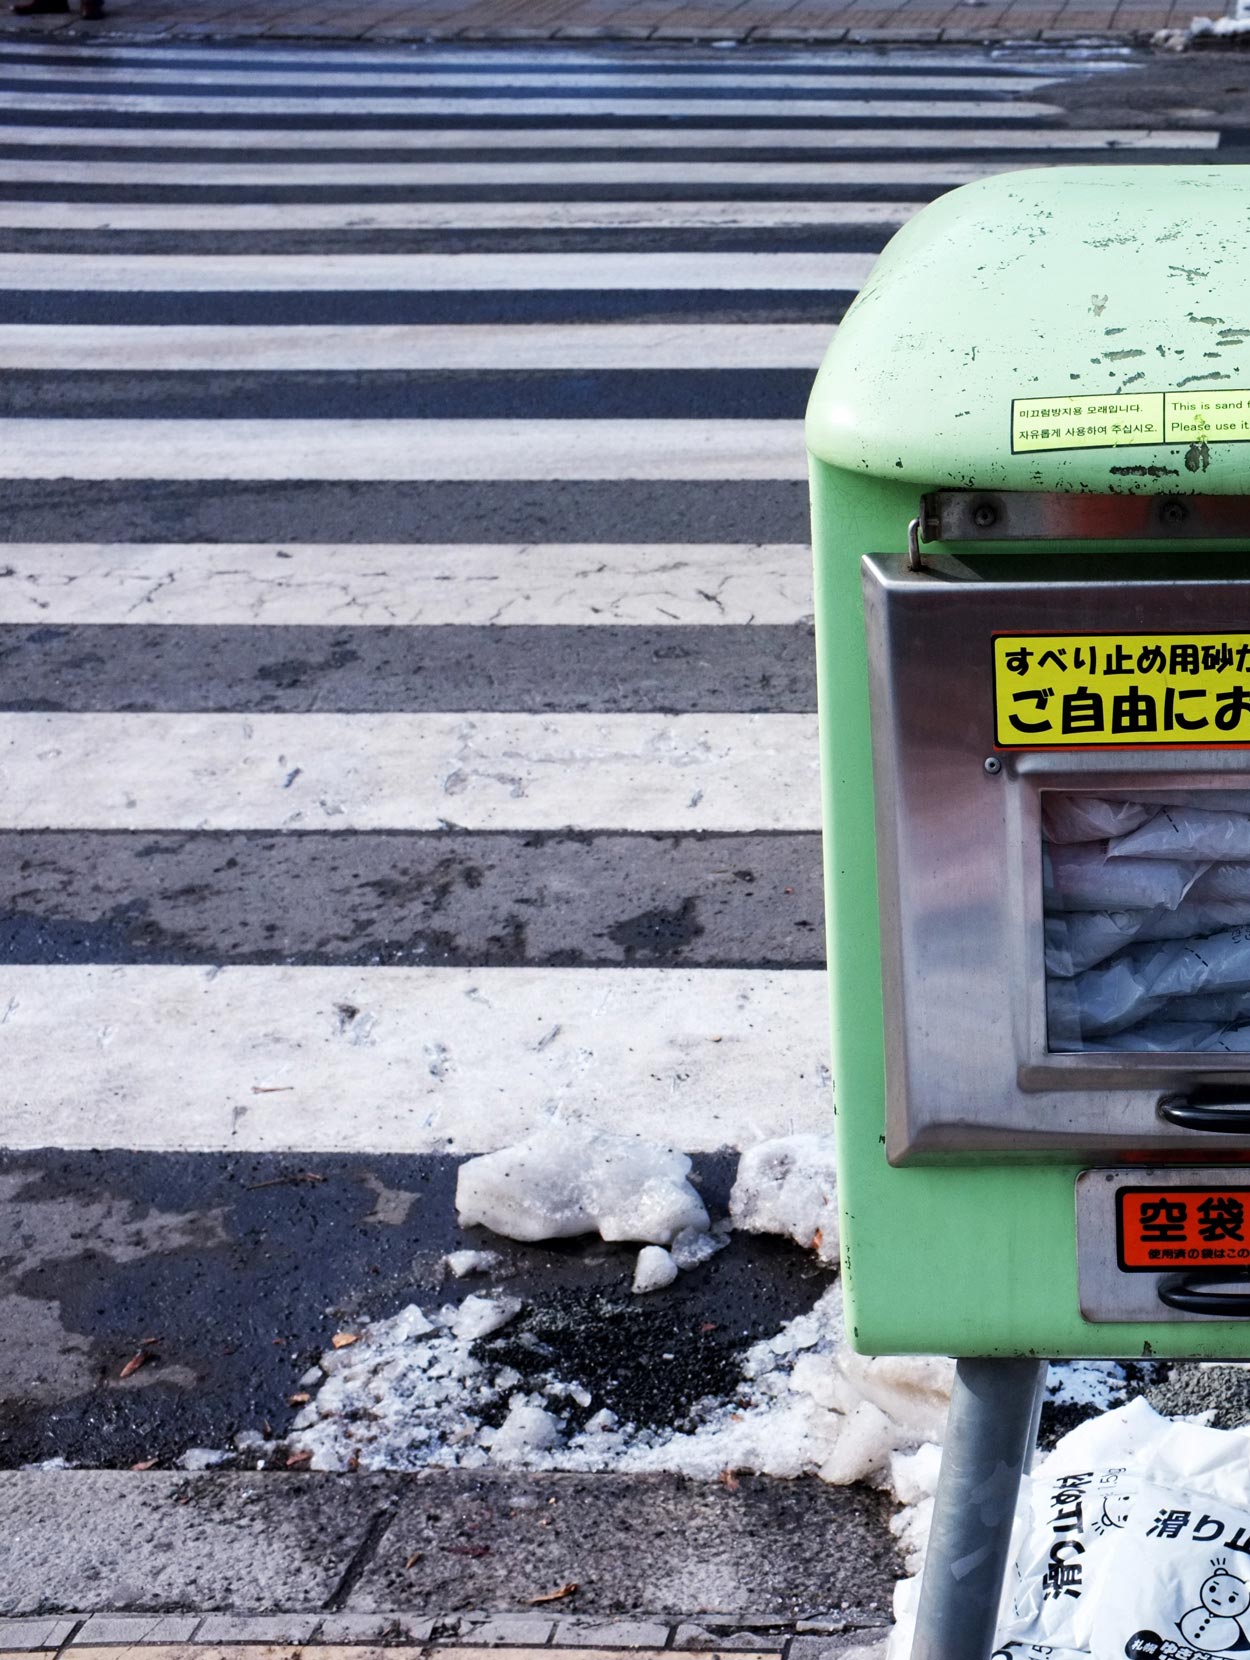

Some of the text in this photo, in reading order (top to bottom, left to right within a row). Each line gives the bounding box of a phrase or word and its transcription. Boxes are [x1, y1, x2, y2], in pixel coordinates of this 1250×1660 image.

[1087, 404, 1143, 414] 모래입니다.
[1171, 402, 1196, 411] This
[1201, 401, 1210, 410] is
[1215, 400, 1243, 410] sand
[1018, 423, 1158, 440] 자유롭게 사용하여 주십시오.
[1171, 421, 1211, 432] Please
[1215, 423, 1237, 431] use
[1241, 420, 1250, 430] it
[1043, 1471, 1094, 1599] 滑り止め材
